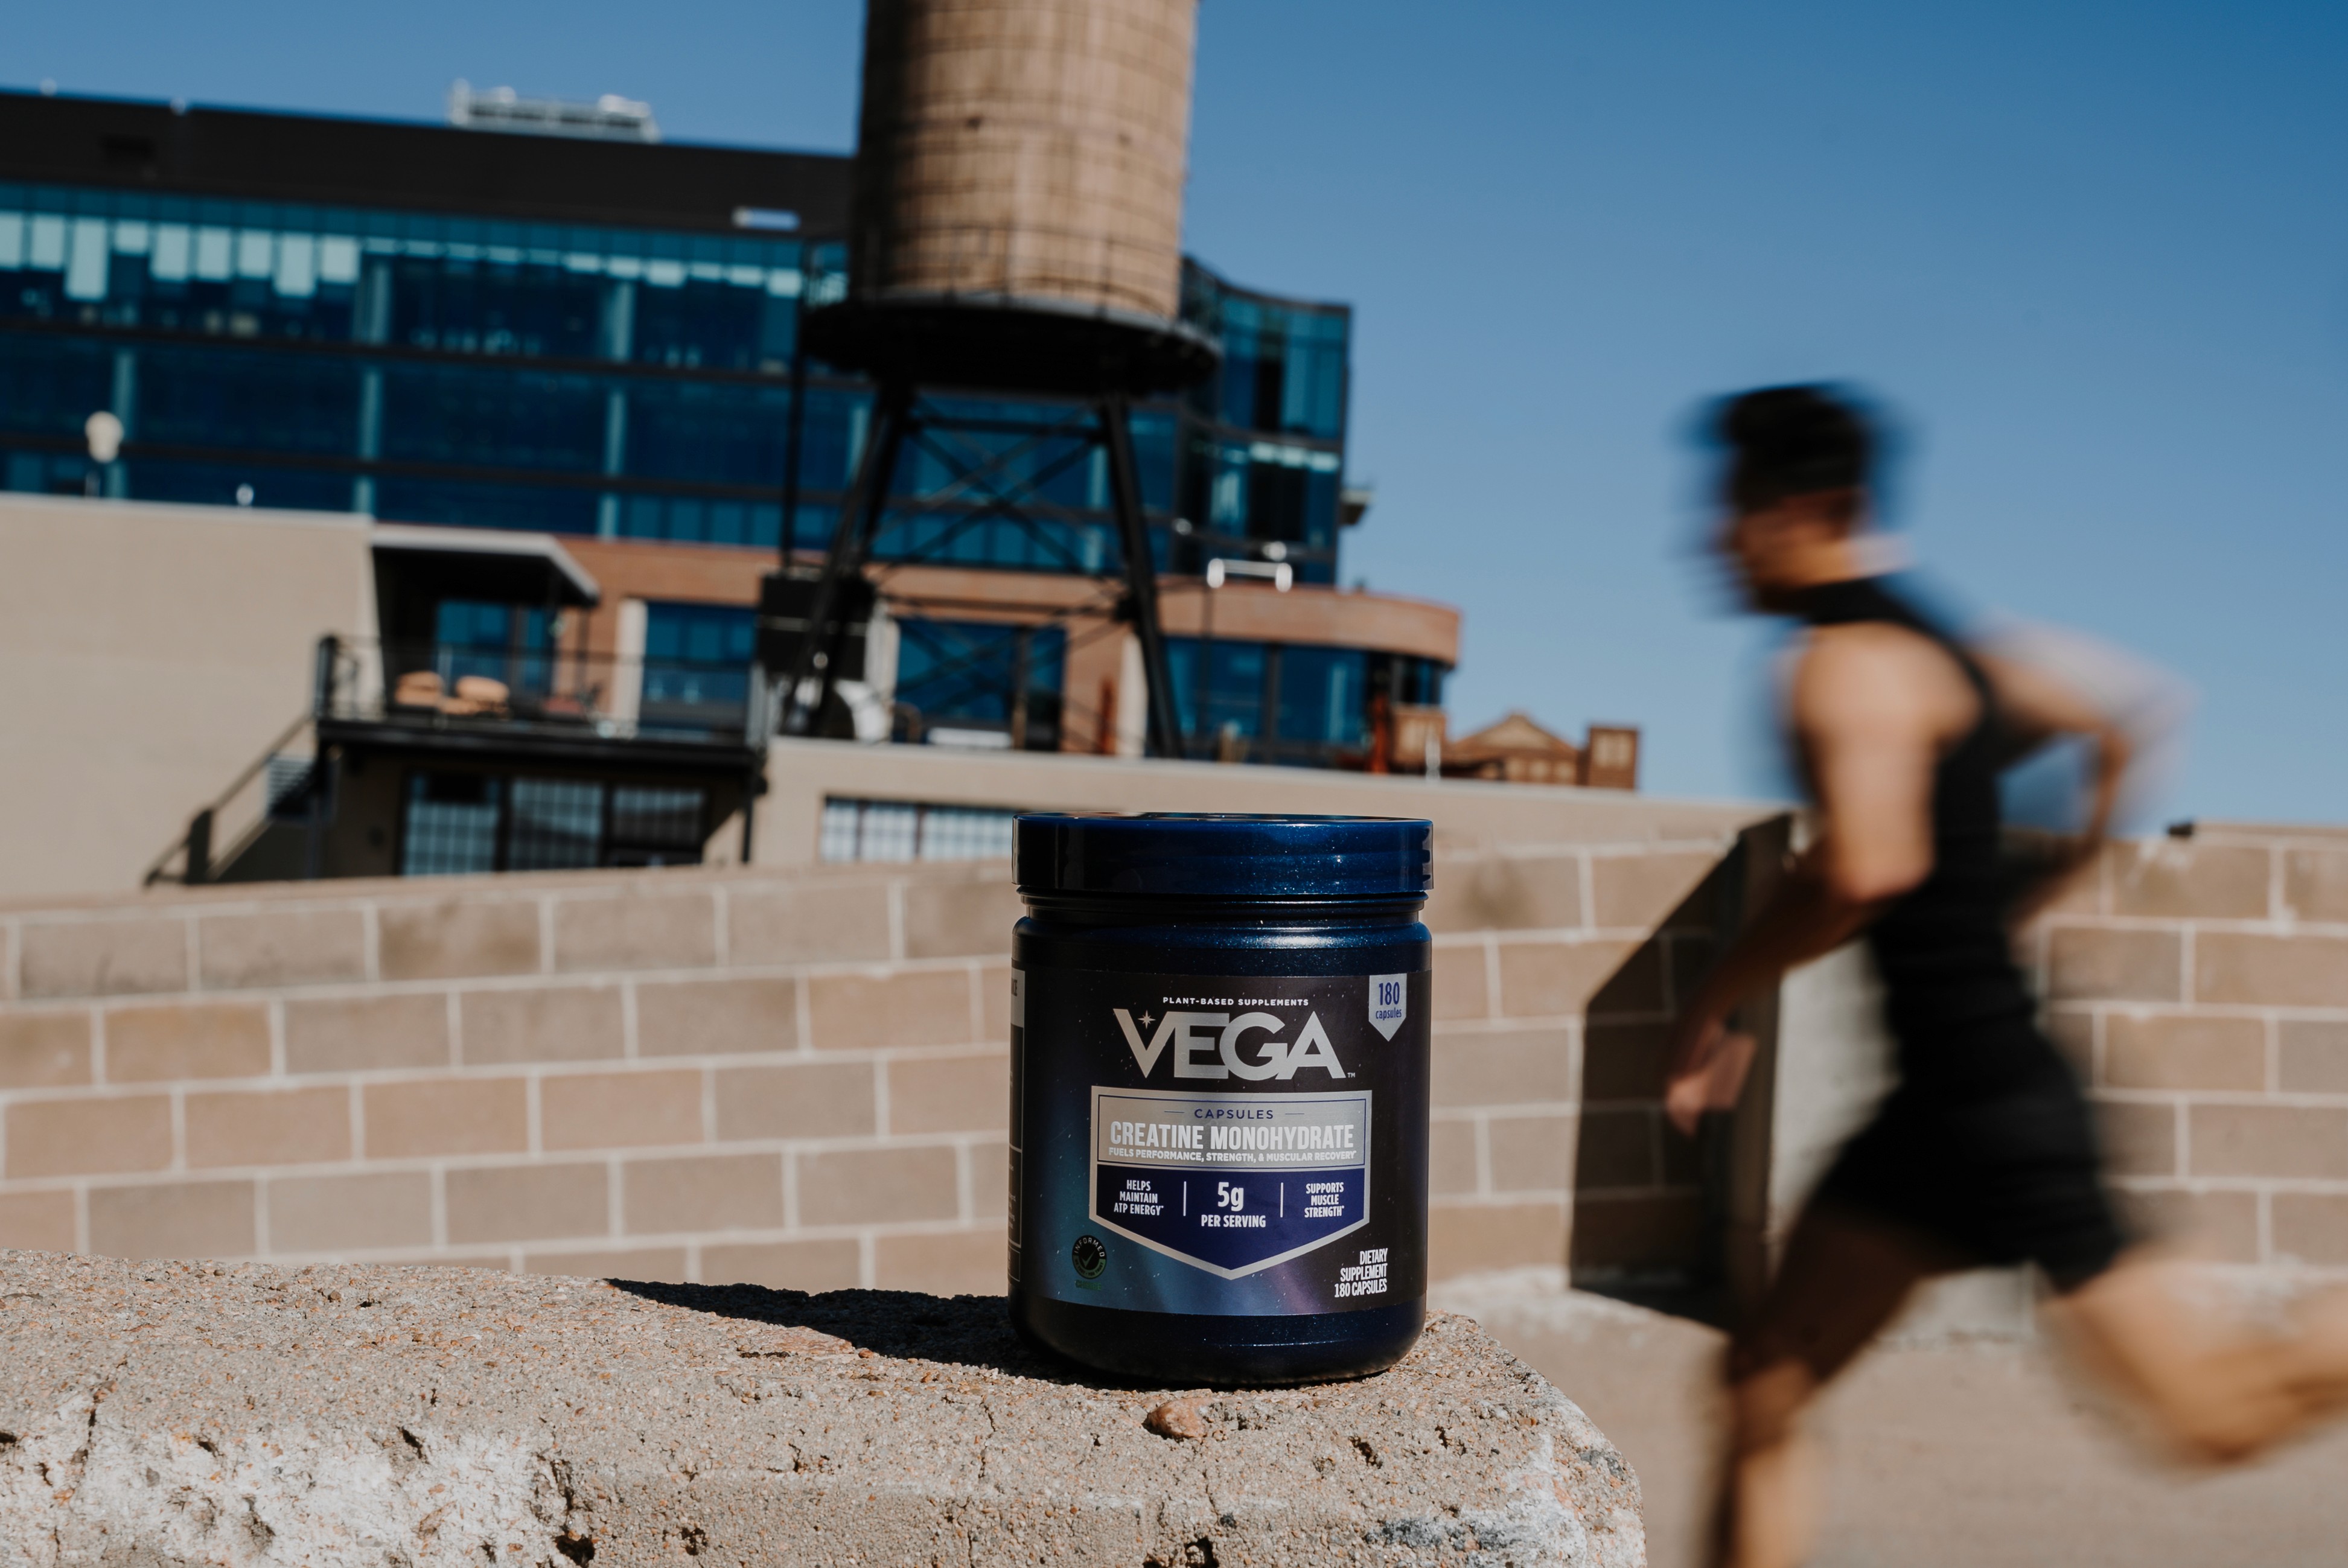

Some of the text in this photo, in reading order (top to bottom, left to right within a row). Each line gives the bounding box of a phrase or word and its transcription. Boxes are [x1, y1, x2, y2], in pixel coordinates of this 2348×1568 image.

[1163, 996, 1234, 1005] PLANT-BASED
[1379, 981, 1400, 1005] 180
[1376, 1007, 1402, 1021] capsules
[1112, 1009, 1347, 1081] VEGA
[1194, 1108, 1274, 1119] CAPSULES
[1110, 1121, 1354, 1150] CREATINE MONOHYDRATE
[1108, 1147, 1134, 1158] FUELS
[1135, 1149, 1205, 1162] PERFORMANCE,
[1205, 1152, 1257, 1164] STRENGTH,
[1258, 1153, 1265, 1162] &
[1266, 1152, 1313, 1162] MUSCULAR
[1126, 1179, 1151, 1191] HELPS
[1306, 1182, 1344, 1194] SUPPORTS
[1120, 1191, 1158, 1203] MAINTAIN
[1217, 1181, 1244, 1212] 5g
[1310, 1194, 1339, 1206] MUSCLE
[1114, 1202, 1128, 1213] ATP
[1201, 1214, 1266, 1228] PER SERVING
[1074, 1237, 1105, 1257] INFORMED
[1359, 1248, 1388, 1265] DIETARY
[1340, 1263, 1388, 1282] SUPPLEMENT
[1334, 1278, 1387, 1298] 180 CAPSULES
